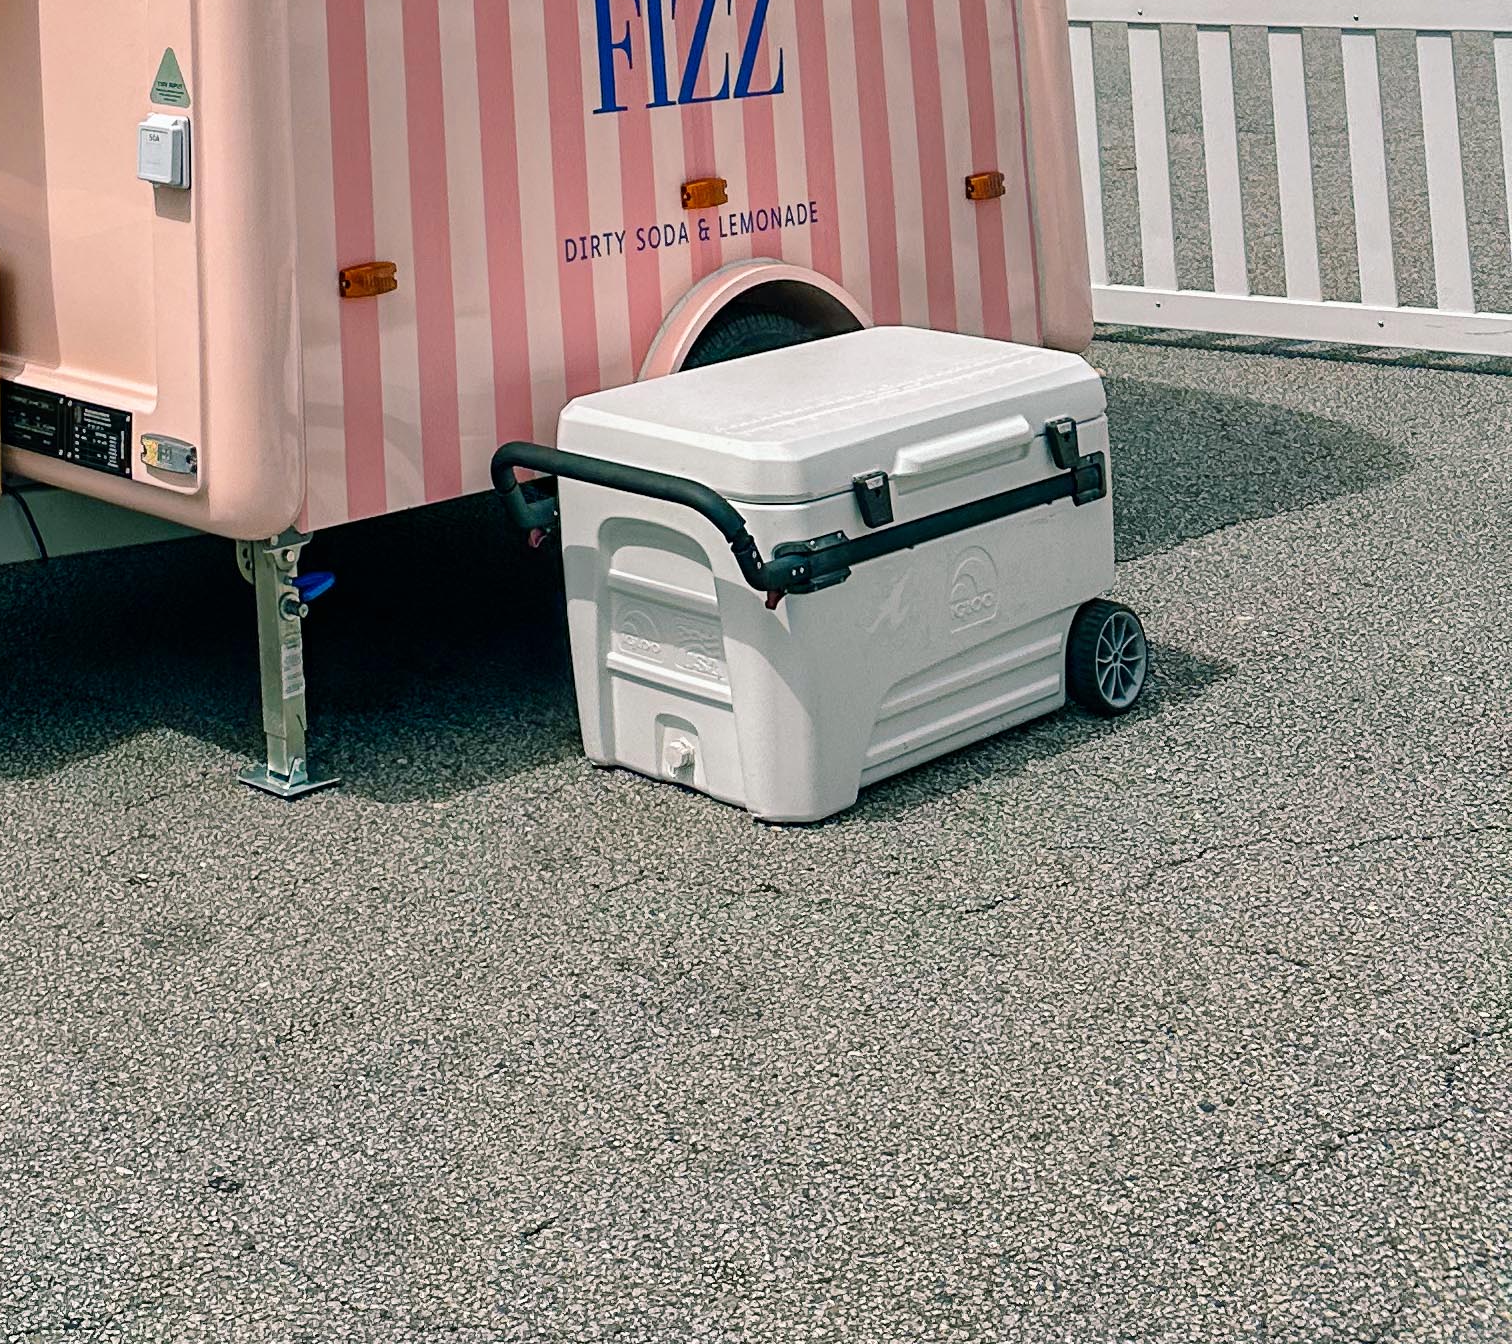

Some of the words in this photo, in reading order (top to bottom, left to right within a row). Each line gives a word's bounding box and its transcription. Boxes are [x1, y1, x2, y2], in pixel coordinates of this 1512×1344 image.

[565, 230, 626, 262] DIRTY
[636, 222, 689, 251] SODA
[698, 218, 710, 240] &
[719, 201, 819, 238] LEMONADE
